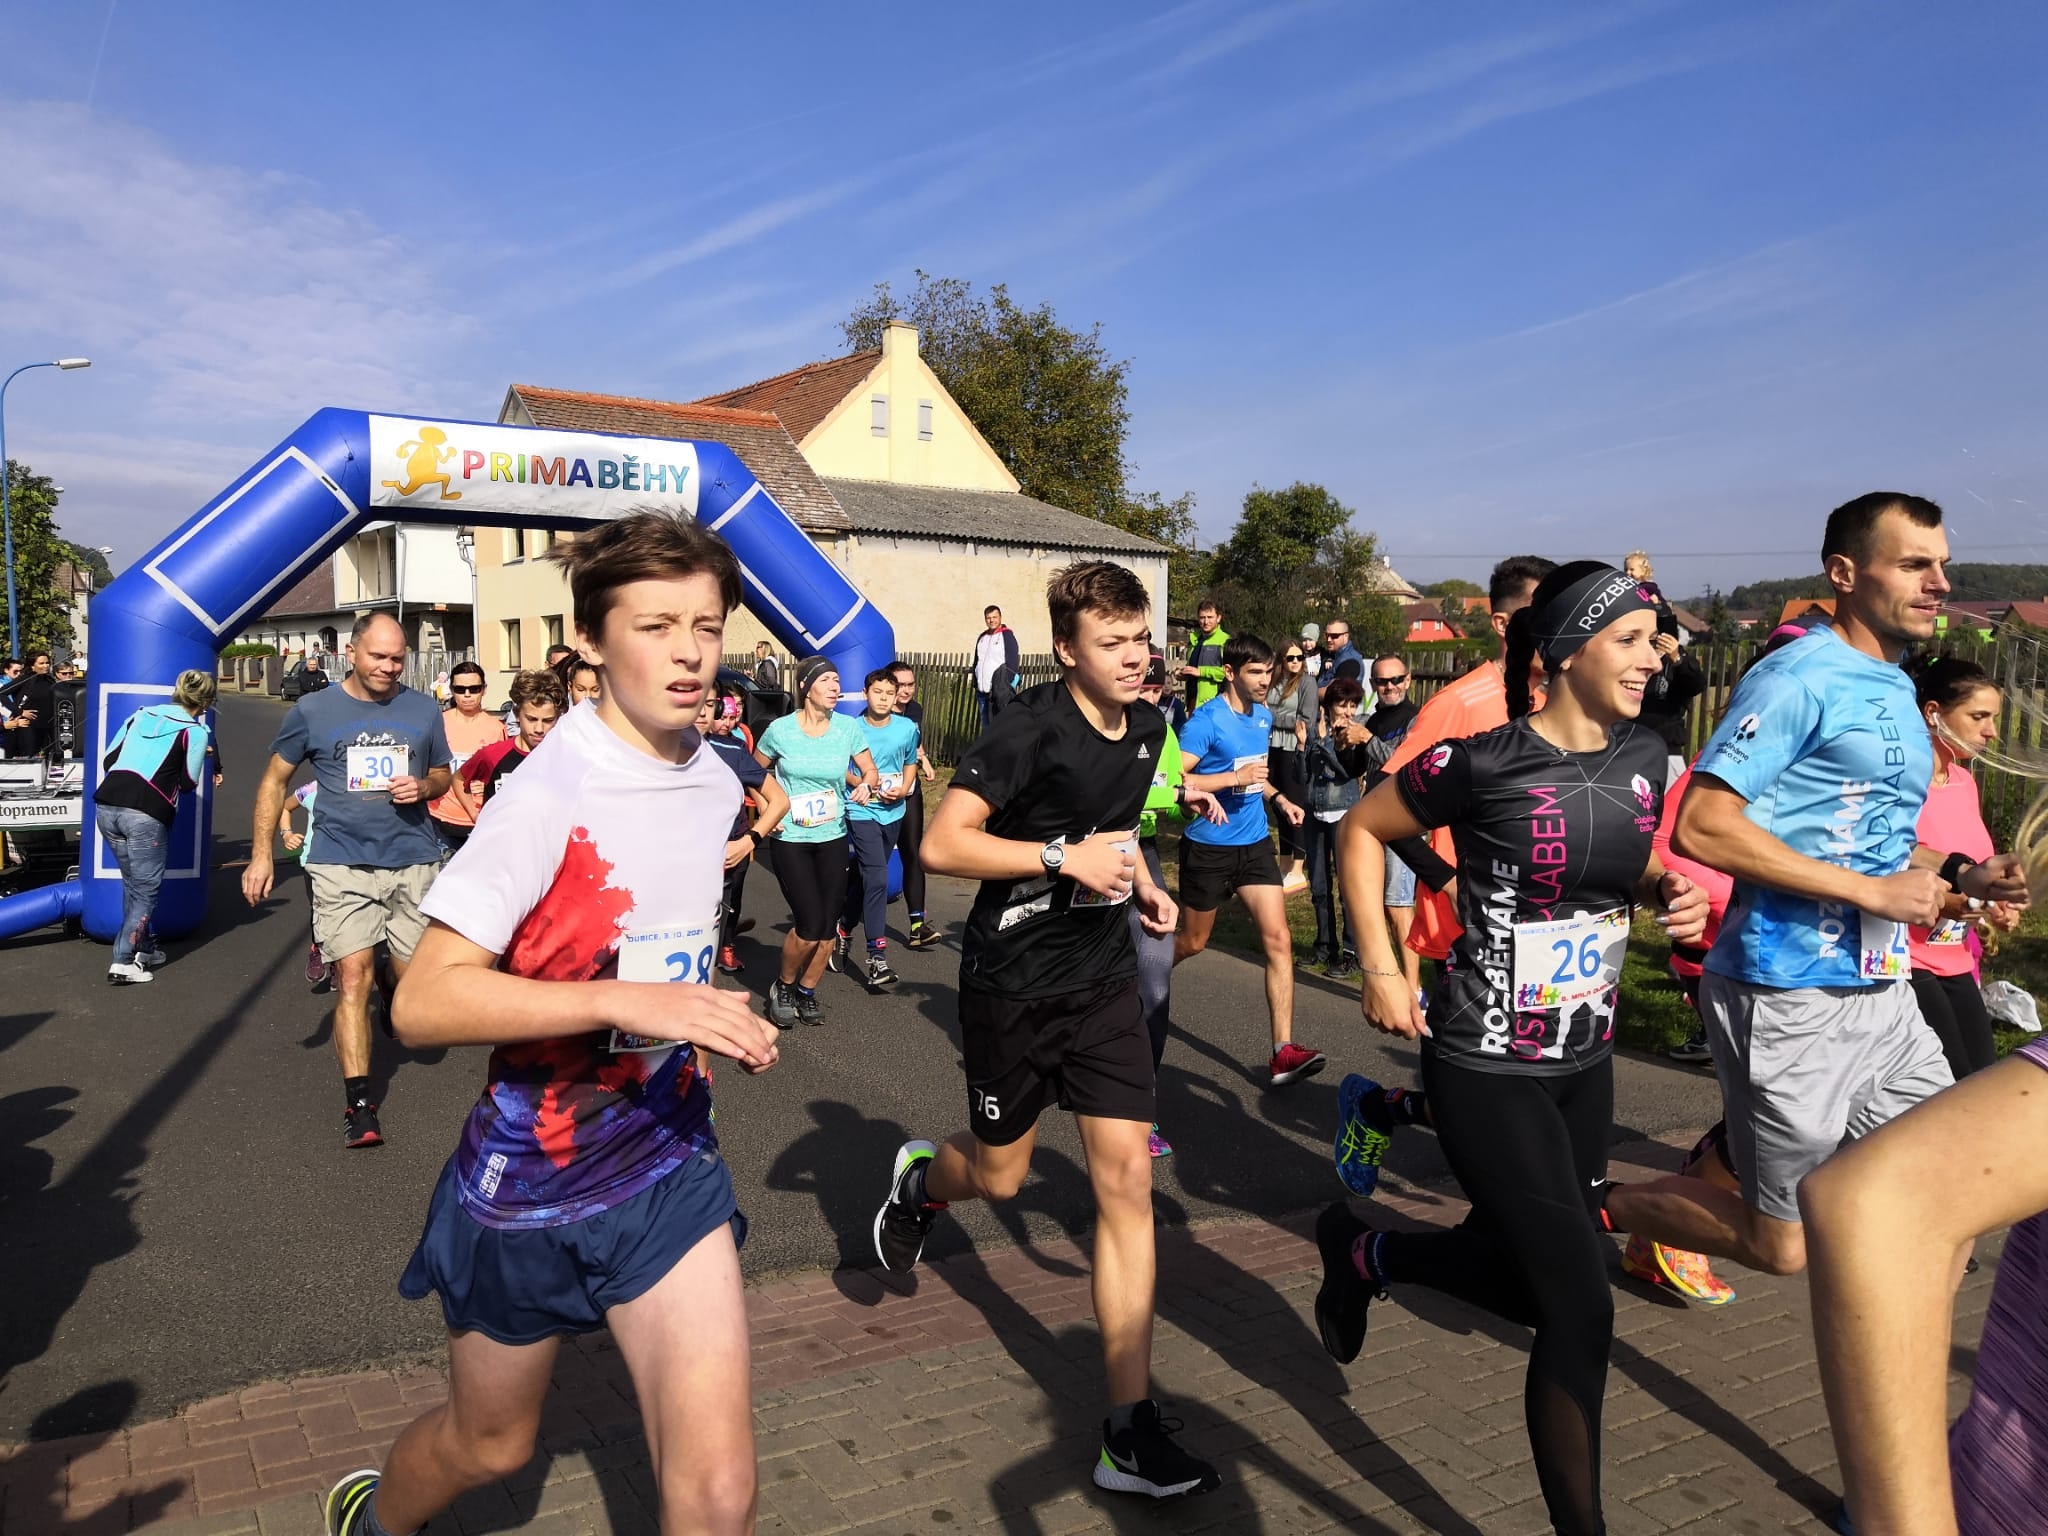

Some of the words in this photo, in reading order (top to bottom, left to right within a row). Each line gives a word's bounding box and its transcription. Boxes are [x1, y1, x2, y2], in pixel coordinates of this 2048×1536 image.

[462, 449, 690, 494] PRIMABĚHY
[364, 755, 394, 778] 30
[806, 799, 826, 817] 12
[1528, 786, 1567, 904] LABEM
[1478, 858, 1520, 1055] ROZBĚHÁME
[1551, 932, 1601, 984] 26
